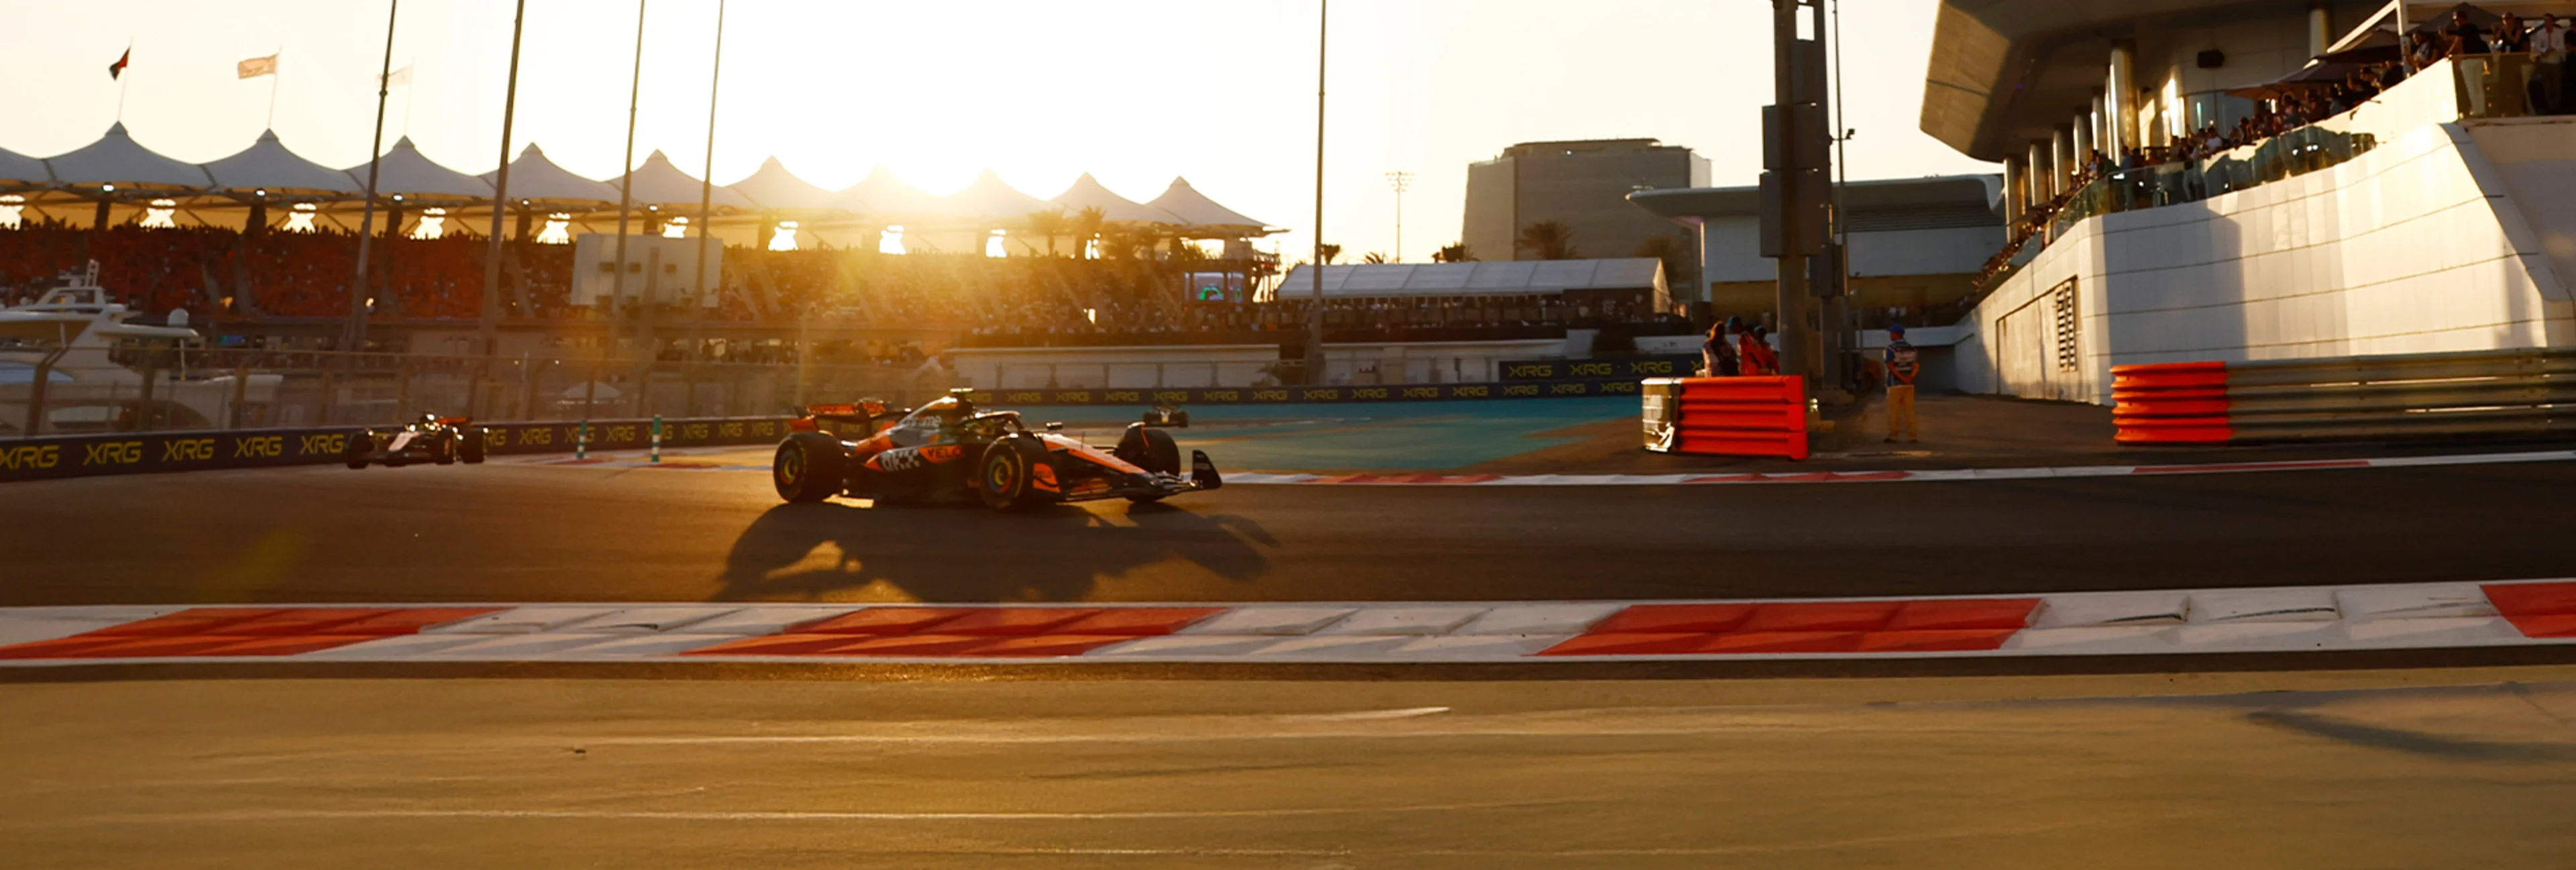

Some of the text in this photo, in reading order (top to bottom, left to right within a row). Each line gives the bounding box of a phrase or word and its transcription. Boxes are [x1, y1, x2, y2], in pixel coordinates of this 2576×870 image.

[1508, 361, 1672, 378] XRG XRG XRG
[1006, 392, 1042, 402] XRG
[1055, 392, 1089, 402] XRG
[1104, 392, 1139, 402] XRG
[1153, 392, 1188, 402] XRG
[1203, 390, 1238, 401] XRG
[1252, 390, 1288, 400] XRG
[1303, 389, 1338, 400] XRG
[1352, 388, 1387, 398] XRG
[1402, 387, 1438, 398] XRG
[1452, 386, 1489, 396] XRG
[1503, 384, 1538, 395] XRG
[1550, 384, 1586, 394] XRG
[1599, 382, 1635, 392] XRG
[0, 445, 60, 470] XRG
[83, 441, 143, 466] XRG
[161, 439, 215, 462] XRG
[233, 436, 282, 458] XRG
[299, 434, 345, 455] XRG
[483, 429, 507, 446] RG
[519, 427, 552, 445] XRG
[606, 425, 636, 442] XRG
[682, 423, 708, 439] XRG
[718, 422, 744, 437] XRG
[751, 421, 774, 437] XRG
